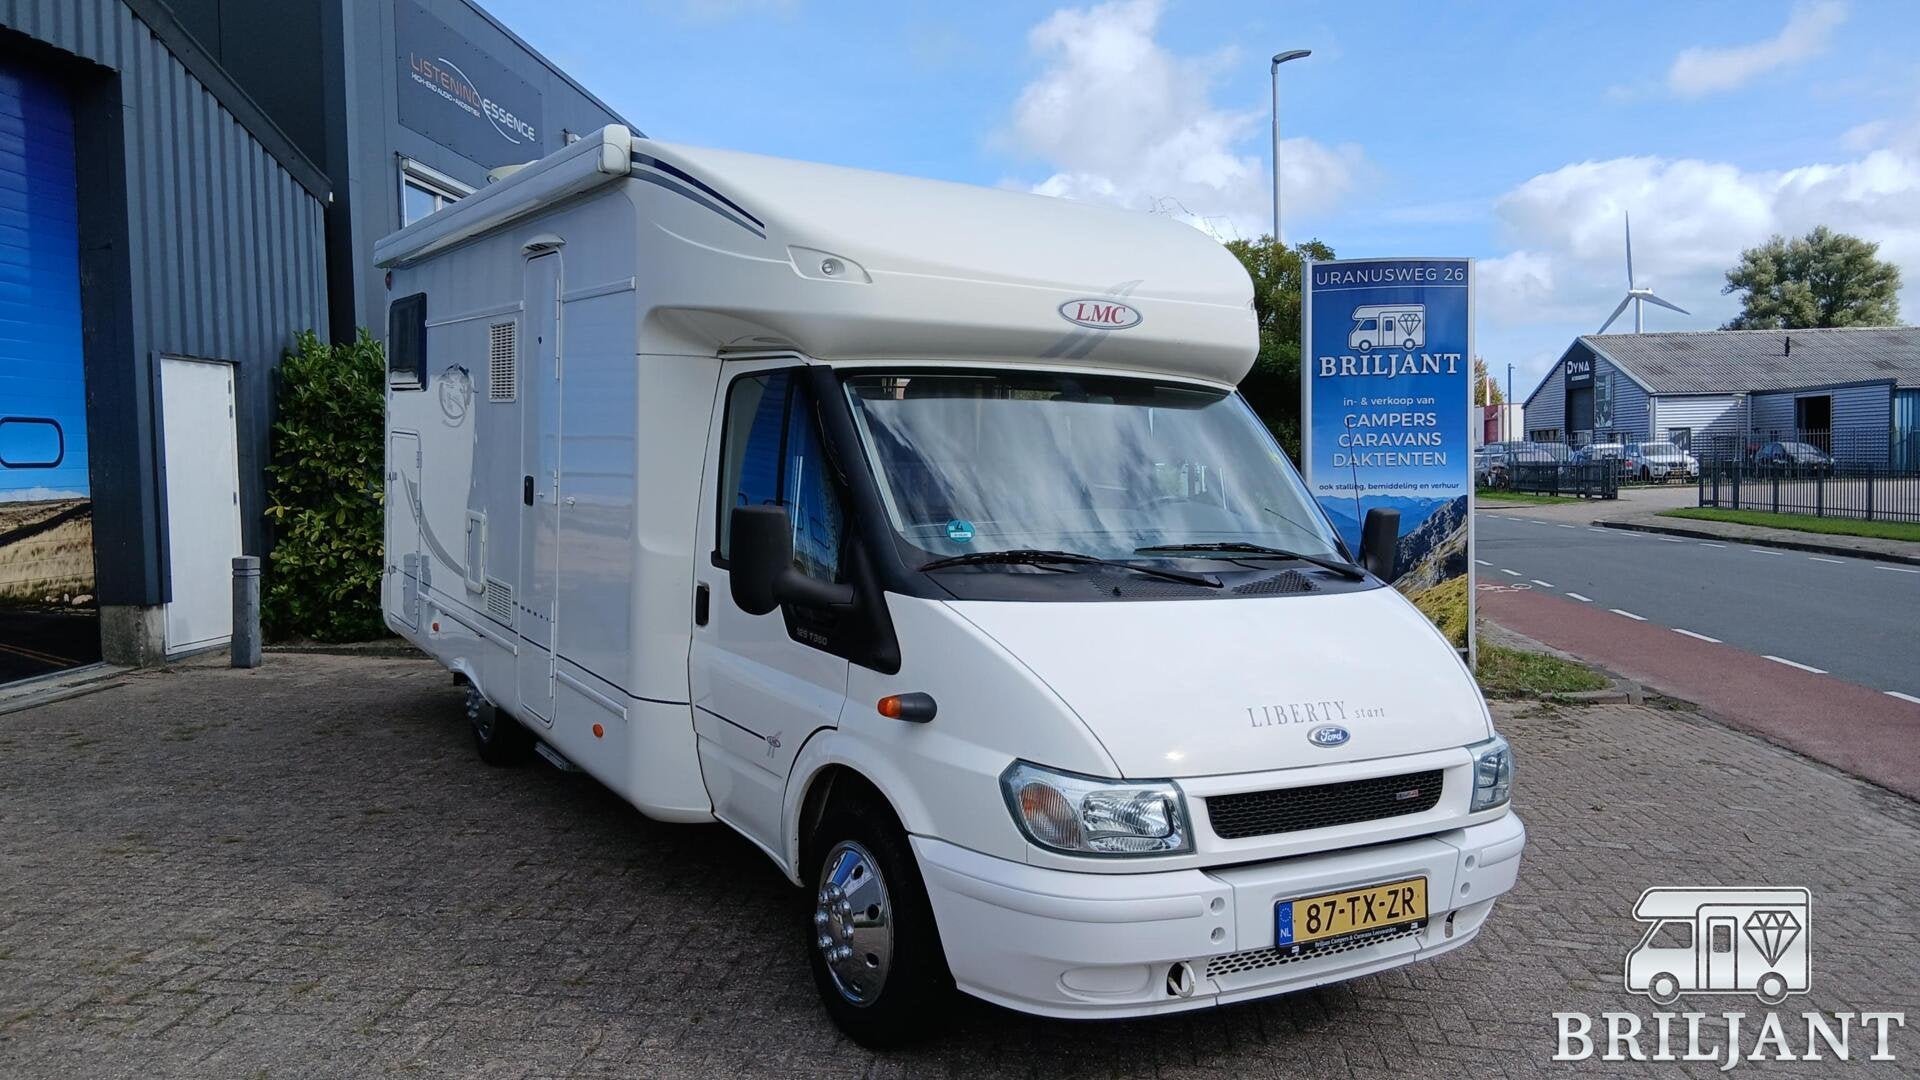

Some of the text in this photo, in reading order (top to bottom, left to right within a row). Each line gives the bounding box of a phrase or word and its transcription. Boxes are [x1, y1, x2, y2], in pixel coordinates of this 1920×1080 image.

[410, 52, 481, 108] LISTENING
[483, 98, 535, 142] ESSENCE
[1316, 267, 1464, 285] URANUSWEG 26
[1076, 302, 1126, 325] LMC
[1319, 353, 1461, 379] BRILJANT
[1567, 360, 1590, 375] DYNA
[1343, 397, 1435, 408] in- & verkoop van
[1344, 412, 1437, 429] CAMPERS
[1338, 431, 1442, 448] CARAVANS
[1333, 451, 1448, 468] DAKTENTEN
[1368, 482, 1418, 491] bemiddeling
[1431, 482, 1460, 490] verhuur
[1246, 700, 1385, 728] LIBERTY start
[1320, 728, 1344, 742] Ford
[1306, 886, 1416, 934] 87-TX-ZR
[1280, 927, 1292, 938] NL
